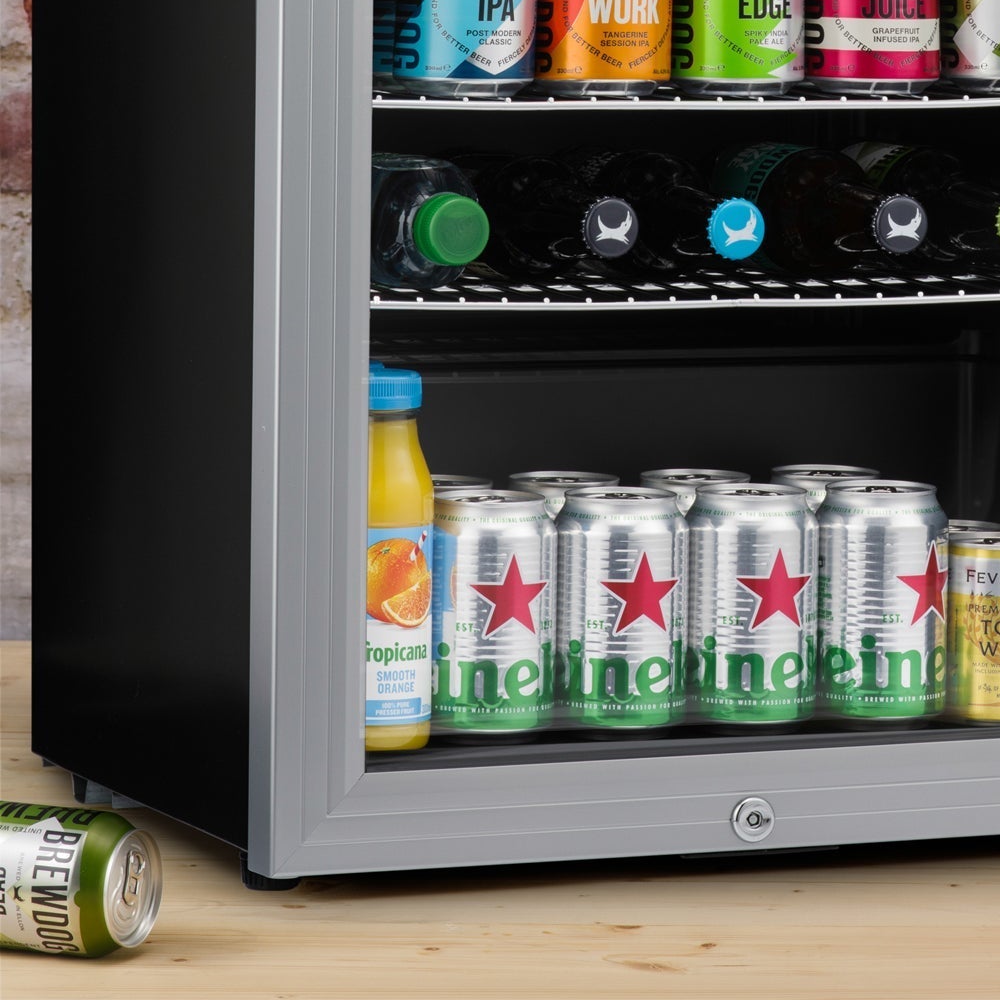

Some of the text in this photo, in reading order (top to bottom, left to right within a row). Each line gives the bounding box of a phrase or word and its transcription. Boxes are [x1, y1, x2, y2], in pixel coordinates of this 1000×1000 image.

[466, 29, 522, 37] POST MODERN
[603, 31, 649, 39] TANGERINE
[872, 27, 920, 35] GRAPEFRUIT
[478, 38, 512, 46] CLASSIC
[843, 30, 872, 54] BETTER
[441, 30, 470, 55] BETTER
[470, 51, 492, 66] BEER
[497, 44, 526, 67] FIERCELY
[571, 32, 601, 57] BETTER
[601, 53, 623, 69] BEER
[628, 46, 658, 69] FIERCELY
[714, 30, 743, 54] BETTER
[743, 52, 765, 66] BEER
[722, 615, 744, 626] EST.
[883, 613, 904, 623] EST.
[587, 619, 609, 630] EST.
[366, 642, 427, 666] ropicana
[377, 670, 416, 682] SMOOTH
[378, 682, 415, 694] ORANGE
[706, 697, 792, 706] BREWED WITH PASSION
[898, 695, 917, 703] WITH
[602, 703, 622, 711] WITH
[626, 703, 657, 711] PASSION
[12, 825, 42, 835] UNITED
[31, 829, 82, 952] BREWDOG
